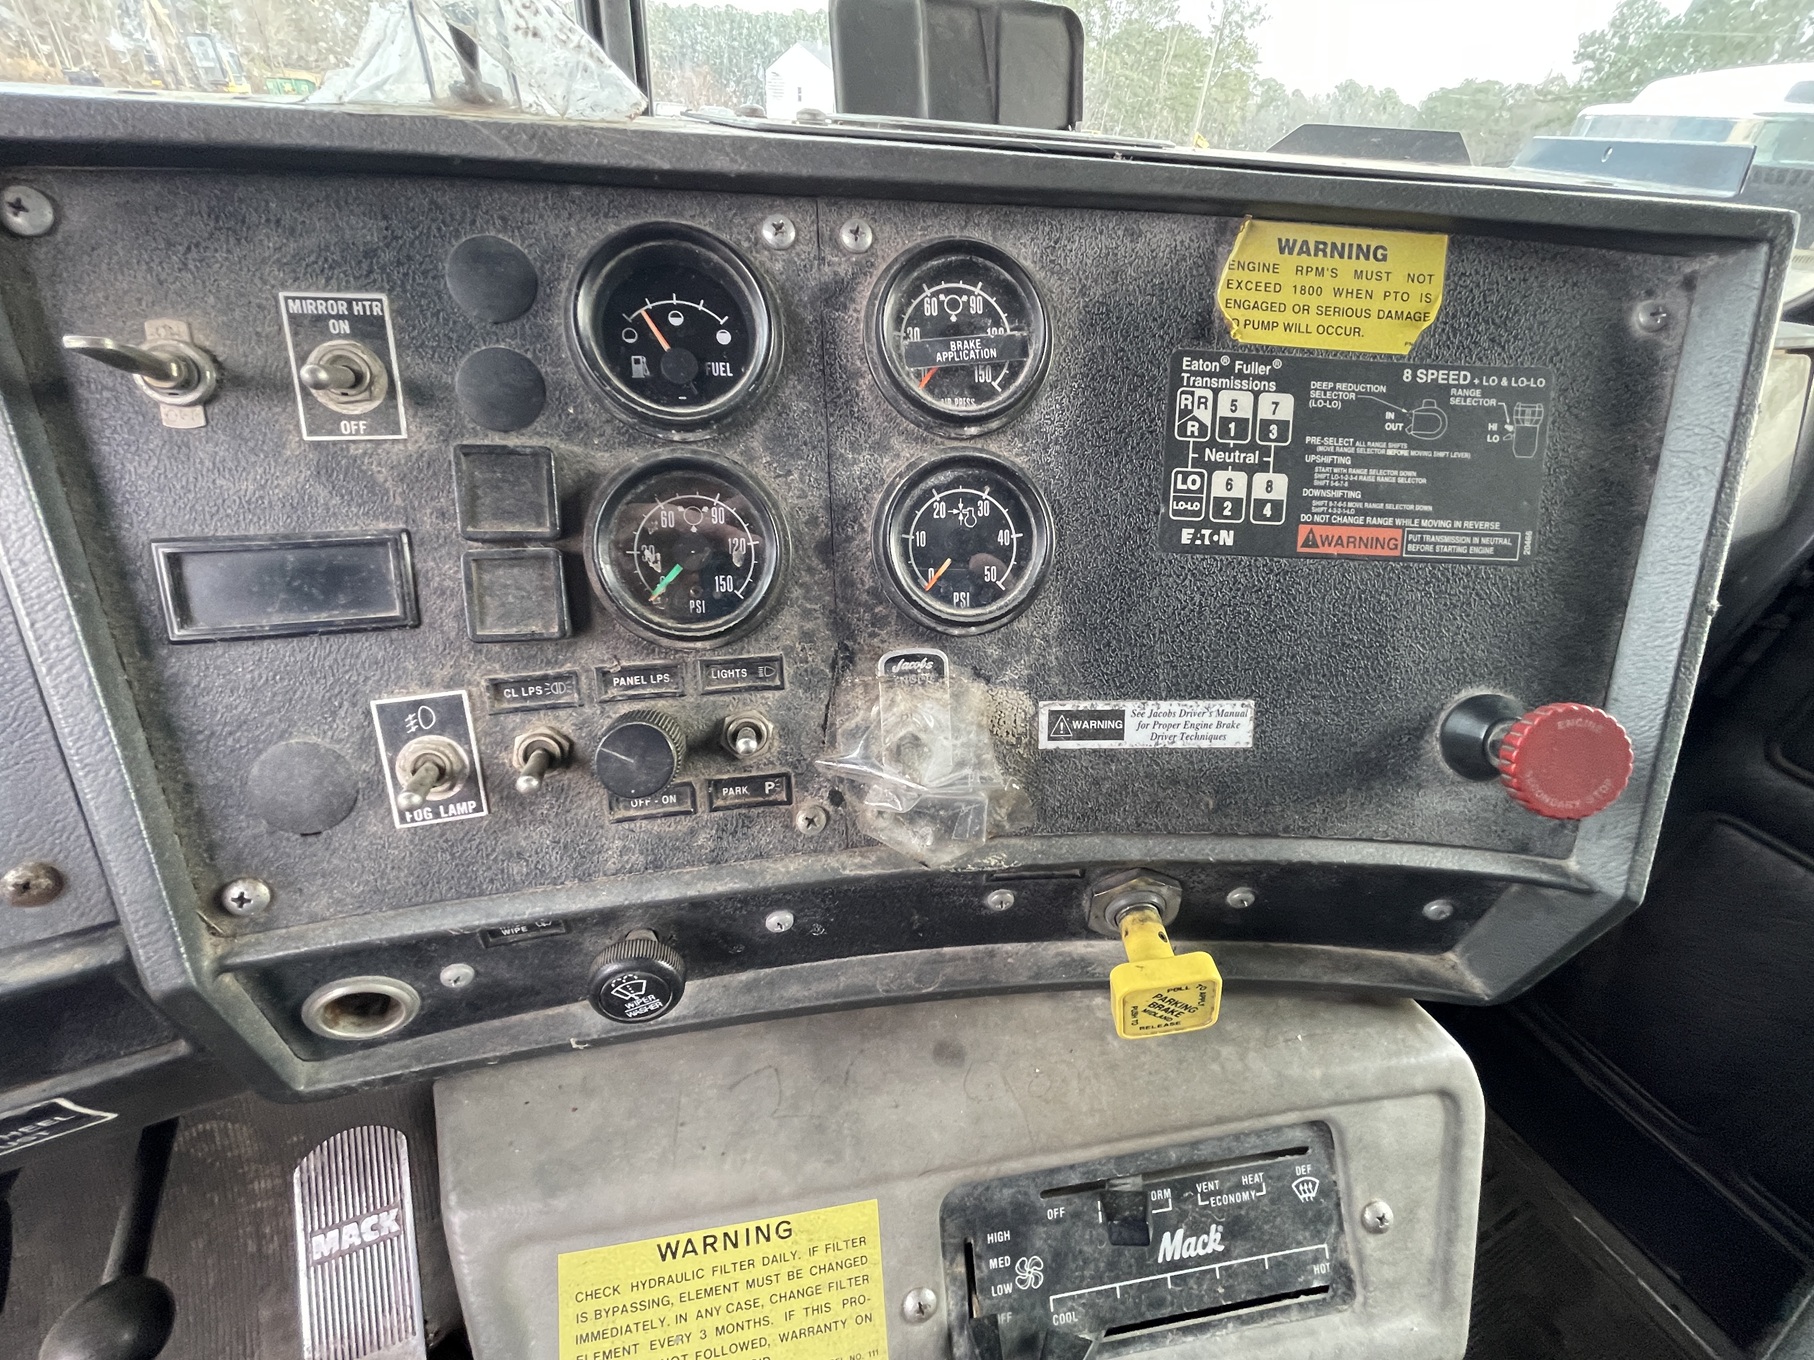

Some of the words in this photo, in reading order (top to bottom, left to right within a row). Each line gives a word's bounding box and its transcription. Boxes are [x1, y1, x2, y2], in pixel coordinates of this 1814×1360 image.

[1277, 237, 1388, 263] WARNING
[1228, 260, 1280, 274] ENGINE
[1295, 265, 1339, 279] RPM'S
[1353, 269, 1392, 282] MUST
[1406, 273, 1436, 285] NOT
[1226, 279, 1282, 293] EXCEED
[1292, 285, 1323, 297] 1800
[1333, 287, 1374, 300] WHEN
[1383, 290, 1410, 302] PTO
[1419, 292, 1433, 304] IS
[287, 298, 349, 315] MIRROR
[352, 300, 383, 316] HTR
[924, 297, 938, 316] 60
[969, 296, 983, 314] 90
[1225, 298, 1287, 313] ENGAGED
[1291, 303, 1311, 315] OR
[1316, 305, 1372, 319] SERIOUS
[1376, 308, 1431, 322] DAMAGE
[328, 319, 351, 334] ON
[1243, 319, 1279, 332] PUMP
[1283, 321, 1313, 335] WILL
[1316, 324, 1365, 338] OCCUR.
[950, 339, 982, 352] BRAKE
[936, 348, 997, 363] APPLICATION
[705, 361, 734, 376] FUEL
[974, 365, 993, 383] 150
[1180, 373, 1277, 391] Transmissions
[1402, 368, 1412, 383] 8
[1416, 369, 1471, 385] SPEED
[1482, 376, 1498, 386] LO
[1511, 377, 1546, 388] LO-LO
[1310, 381, 1334, 390] DEEP
[1336, 383, 1387, 393] REDUCTION
[1450, 388, 1482, 397] RANGE
[1180, 394, 1193, 409] R
[1197, 395, 1209, 410] R
[1310, 390, 1356, 400] SELECTOR
[1449, 397, 1497, 407] SELECTOR
[1229, 399, 1238, 413] 5
[1271, 401, 1280, 415] 7
[1308, 399, 1342, 410] (LO-LO)
[340, 420, 367, 435] OFF
[1186, 421, 1199, 436] R
[1228, 422, 1236, 437] 1
[1268, 424, 1278, 439] 3
[1384, 422, 1404, 431] OUT
[1305, 436, 1354, 446] PRE-SELECT
[1204, 447, 1260, 464] Neutral
[1304, 454, 1352, 465] UPSHIFTING
[1176, 473, 1201, 490] LO
[1225, 477, 1234, 492] 6
[1265, 479, 1274, 493] 8
[1302, 488, 1362, 499] DOWNSHIFTING
[933, 501, 947, 519] 20
[977, 500, 990, 517] 30
[1173, 500, 1200, 510] LO-LO
[1222, 500, 1233, 516] 2
[1262, 502, 1272, 518] 4
[661, 511, 675, 528] 60
[711, 507, 725, 524] 90
[1314, 514, 1331, 523] NOT
[1331, 515, 1365, 525] CHANGE
[1366, 517, 1394, 526] RANGE
[1395, 518, 1419, 527] WHILE
[1421, 519, 1452, 529] MOVING
[1463, 521, 1500, 530] REVERSE
[915, 531, 926, 547] 10
[997, 529, 1010, 546] 40
[1319, 534, 1399, 551] WARNING
[1422, 534, 1471, 544] TRANSMISSION
[1481, 536, 1512, 546] NEUTRAL
[728, 538, 746, 555] 120
[1435, 544, 1467, 554] STARTING
[1469, 546, 1494, 555] ENGINE
[984, 566, 997, 582] 50
[714, 575, 734, 593] 150
[689, 600, 706, 614] PSI
[953, 592, 970, 608] PSI
[892, 657, 934, 673] Jacobs
[612, 674, 648, 687] PANEL
[650, 672, 671, 685] LPS
[711, 668, 748, 679] LIGHTS
[502, 688, 518, 699] CL
[521, 685, 543, 697] LPS
[1130, 709, 1145, 718] See
[1147, 709, 1177, 719] Jacobs
[1215, 708, 1248, 718] Manual
[1072, 720, 1123, 730] WARNING
[1136, 721, 1150, 732] for
[1152, 721, 1181, 732] Proper
[1183, 721, 1214, 731] Engine
[1216, 720, 1241, 730] Brake
[1150, 732, 1177, 742] Driver
[1179, 732, 1227, 743] Techniques
[722, 785, 749, 796] PARK
[661, 794, 677, 805] ON
[405, 807, 433, 822] FOG
[439, 800, 477, 818] LAMP
[501, 925, 528, 936] WIPE
[624, 994, 656, 1009] WIPER
[1152, 993, 1199, 1014] PARKING
[1147, 1001, 1185, 1018] BRAKE
[1139, 1020, 1182, 1031] RELEASE
[1295, 1164, 1312, 1176] DEF
[1195, 1180, 1220, 1193] VENT
[1241, 1172, 1265, 1186] HEAT
[1151, 1188, 1172, 1201] ORM
[1210, 1191, 1256, 1207] ECONOMY
[1046, 1207, 1066, 1220] OFF
[312, 1207, 400, 1261] MACK
[656, 1219, 794, 1263] WARNING
[987, 1230, 1011, 1244] HIGH
[575, 1284, 621, 1303] CHECK
[630, 1268, 705, 1292] HYDRAULIC
[711, 1258, 756, 1277] FILTER
[761, 1250, 802, 1267] DAILY.
[808, 1245, 819, 1257] IF
[825, 1236, 867, 1254] FILTER
[989, 1256, 1011, 1269] MED
[1313, 1262, 1331, 1275] HOT
[576, 1311, 588, 1324] IS
[594, 1295, 674, 1320] BYPASSING,
[679, 1281, 739, 1303] ELEMENT
[746, 1273, 781, 1290] MUST
[787, 1269, 803, 1281] BE
[809, 1255, 868, 1277] CHANGED
[991, 1282, 1014, 1297] LOW
[575, 1317, 670, 1345] IMMEDIATELY.
[675, 1312, 688, 1325] IN
[695, 1305, 722, 1321] ANY
[725, 1297, 764, 1315] CASE,
[769, 1284, 823, 1305] CHANGE
[828, 1274, 870, 1293] FILTER
[650, 1332, 692, 1351] EVERY
[699, 1329, 707, 1341] 3
[715, 1316, 774, 1337] MONTHS.
[784, 1309, 796, 1322] IF
[803, 1302, 832, 1318] THIS
[842, 1294, 871, 1309] PRO-
[1052, 1311, 1079, 1326] COOL
[695, 1336, 771, 1360] FOLLOWED,
[779, 1318, 848, 1344] WARRANTY
[855, 1312, 873, 1325] ON
